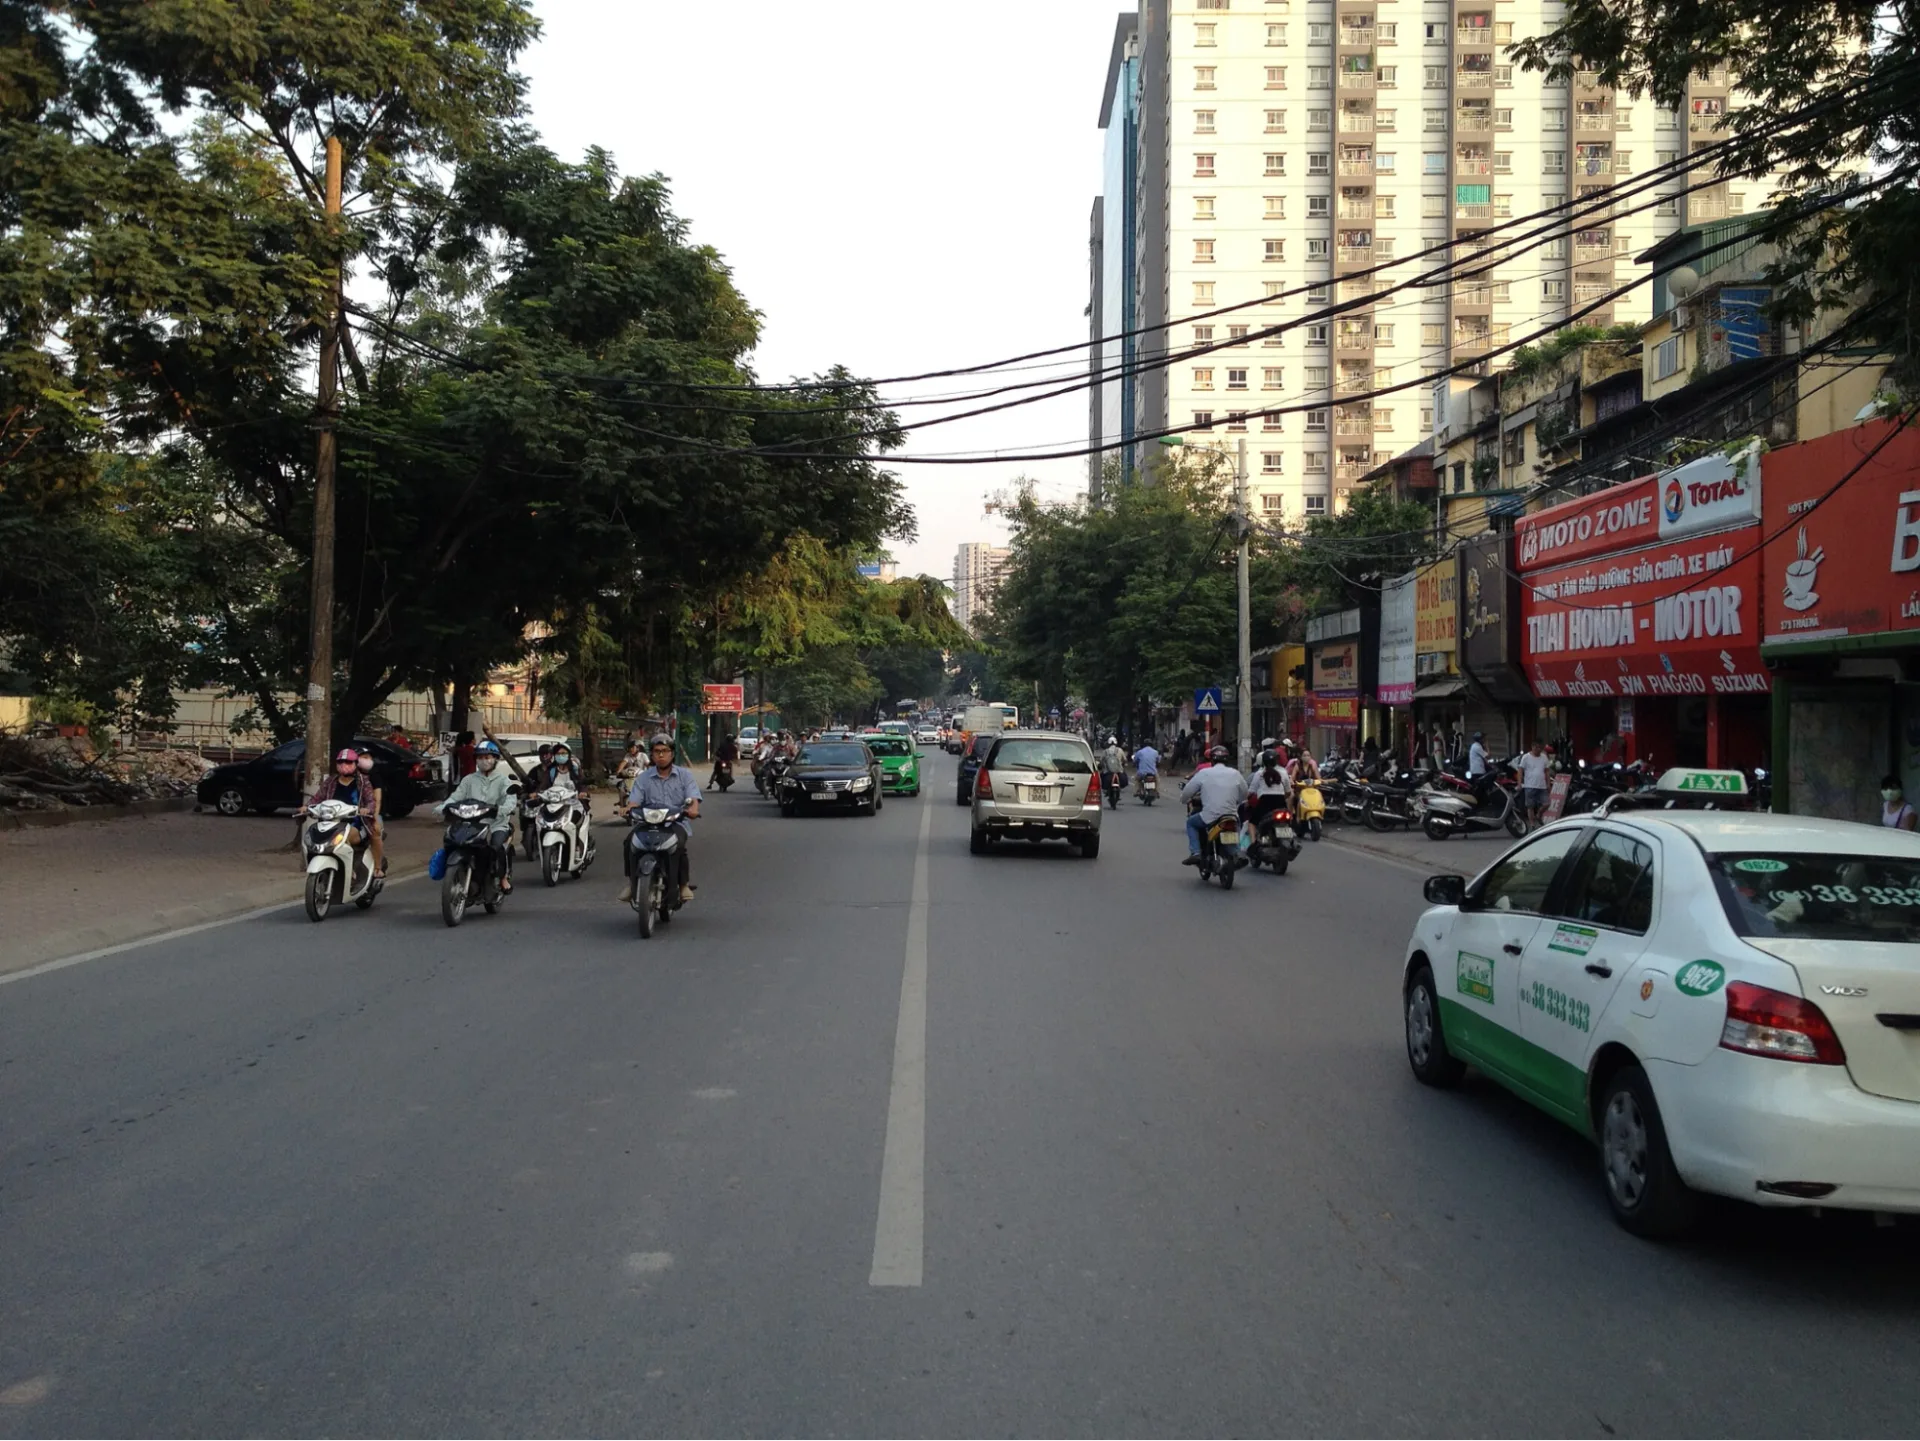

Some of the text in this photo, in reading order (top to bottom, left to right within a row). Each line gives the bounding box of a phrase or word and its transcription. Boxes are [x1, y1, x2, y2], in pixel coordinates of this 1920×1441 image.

[1687, 477, 1745, 507] TOTAL
[1540, 496, 1653, 551] MOTO ZONE
[1559, 576, 1578, 598] TÂM
[1579, 569, 1598, 594] BẢO
[1598, 566, 1632, 591] DƯỠNG
[1632, 557, 1655, 584] SỬA
[1655, 553, 1687, 580] CHỮA
[1688, 553, 1705, 575] XE
[1706, 543, 1734, 571] MÁY
[1527, 611, 1565, 653] THAI
[1568, 601, 1634, 649] HONDA
[1654, 585, 1742, 643] MOTOR
[1565, 680, 1615, 696] HONDA
[1618, 675, 1646, 696] SYM
[1646, 673, 1706, 693] PIAGGIO
[1711, 673, 1769, 692] SUZUKI
[1743, 860, 1781, 871] 9622
[1811, 884, 1859, 903] 38
[1682, 964, 1719, 993] 9622
[1819, 985, 1868, 997] VIOS
[1532, 981, 1545, 1011] 38
[1546, 987, 1567, 1022] 333
[1568, 997, 1590, 1033] 333
